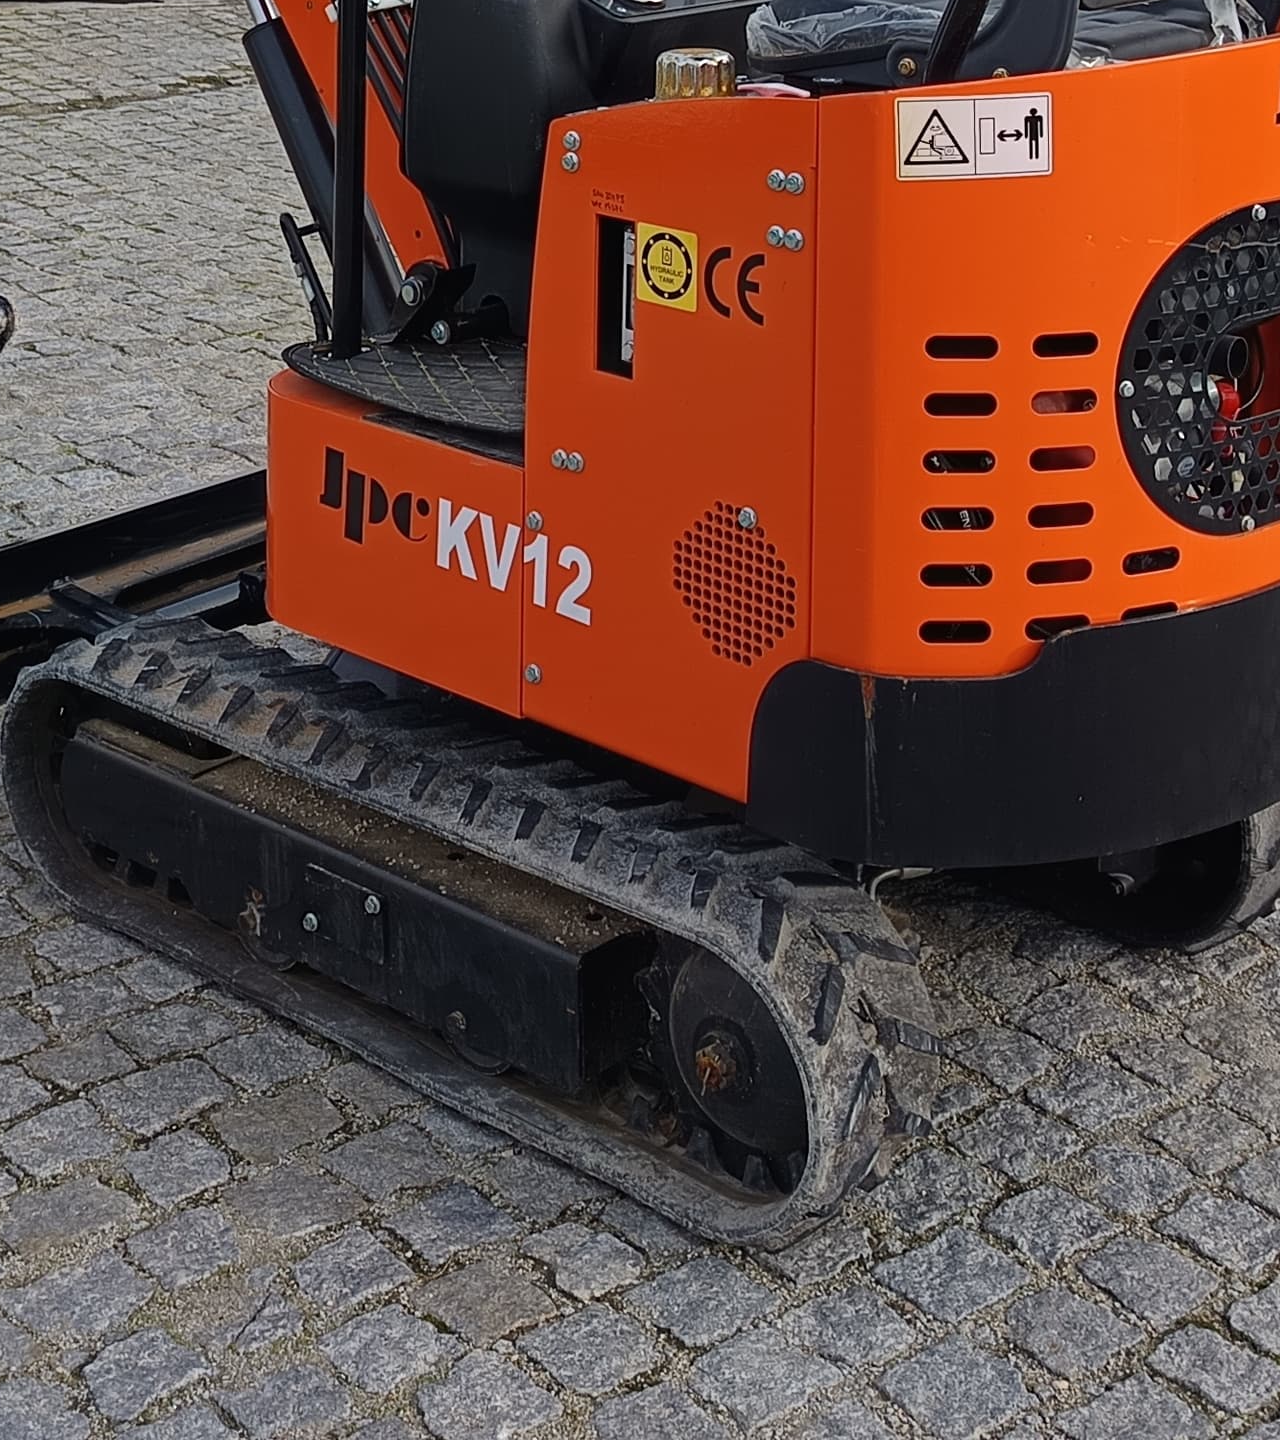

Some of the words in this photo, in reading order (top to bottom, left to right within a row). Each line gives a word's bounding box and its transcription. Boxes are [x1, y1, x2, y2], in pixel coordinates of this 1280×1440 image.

[650, 264, 684, 278] HYDRAULIC
[658, 275, 674, 285] TANK
[704, 246, 766, 325] CE
[436, 497, 593, 626] KV12
